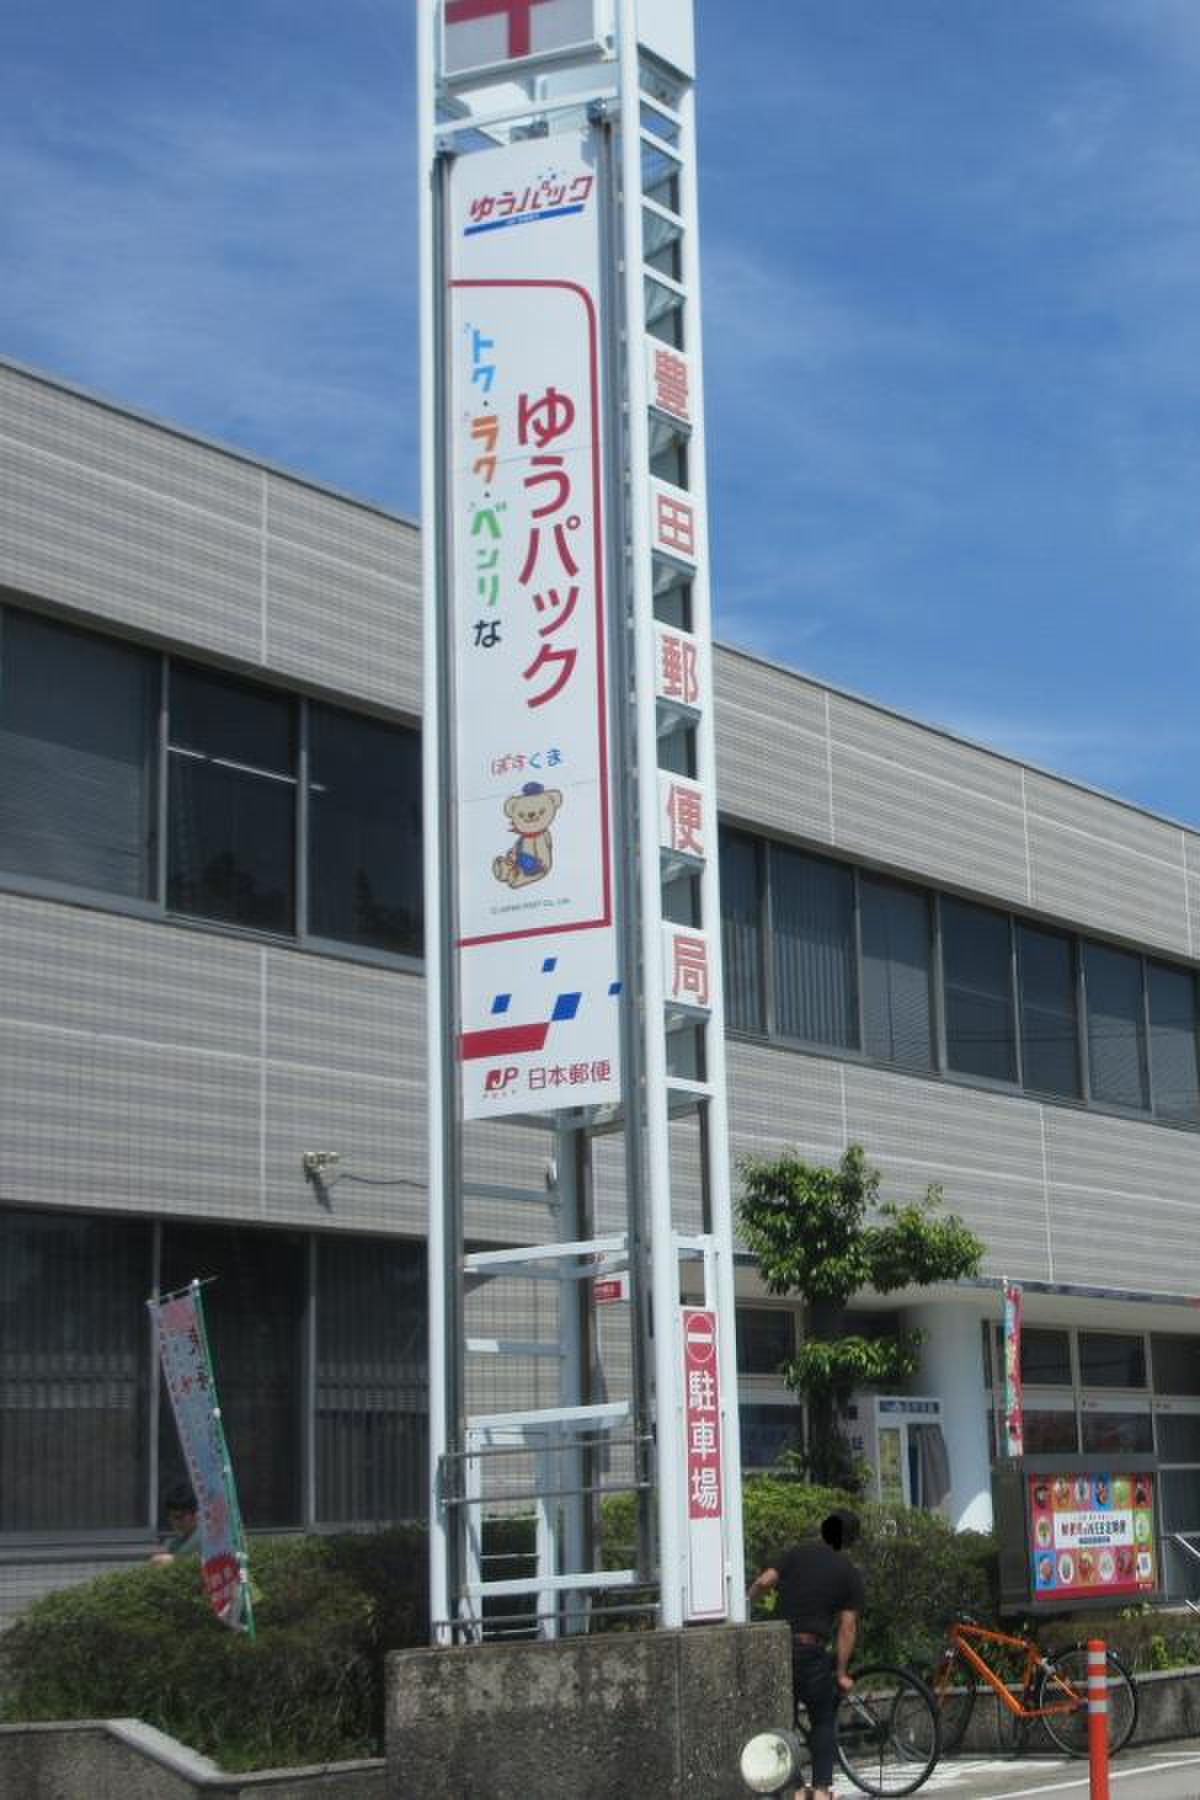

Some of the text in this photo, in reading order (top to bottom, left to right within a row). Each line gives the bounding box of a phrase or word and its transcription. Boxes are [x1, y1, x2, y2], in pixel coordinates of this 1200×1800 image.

[470, 175, 594, 222] ゆうパック
[517, 387, 581, 708] ゆうパック
[655, 350, 708, 1005] 豊田郵便局
[528, 1060, 610, 1090] 日本郵便
[688, 1370, 718, 1510] 駐車場
